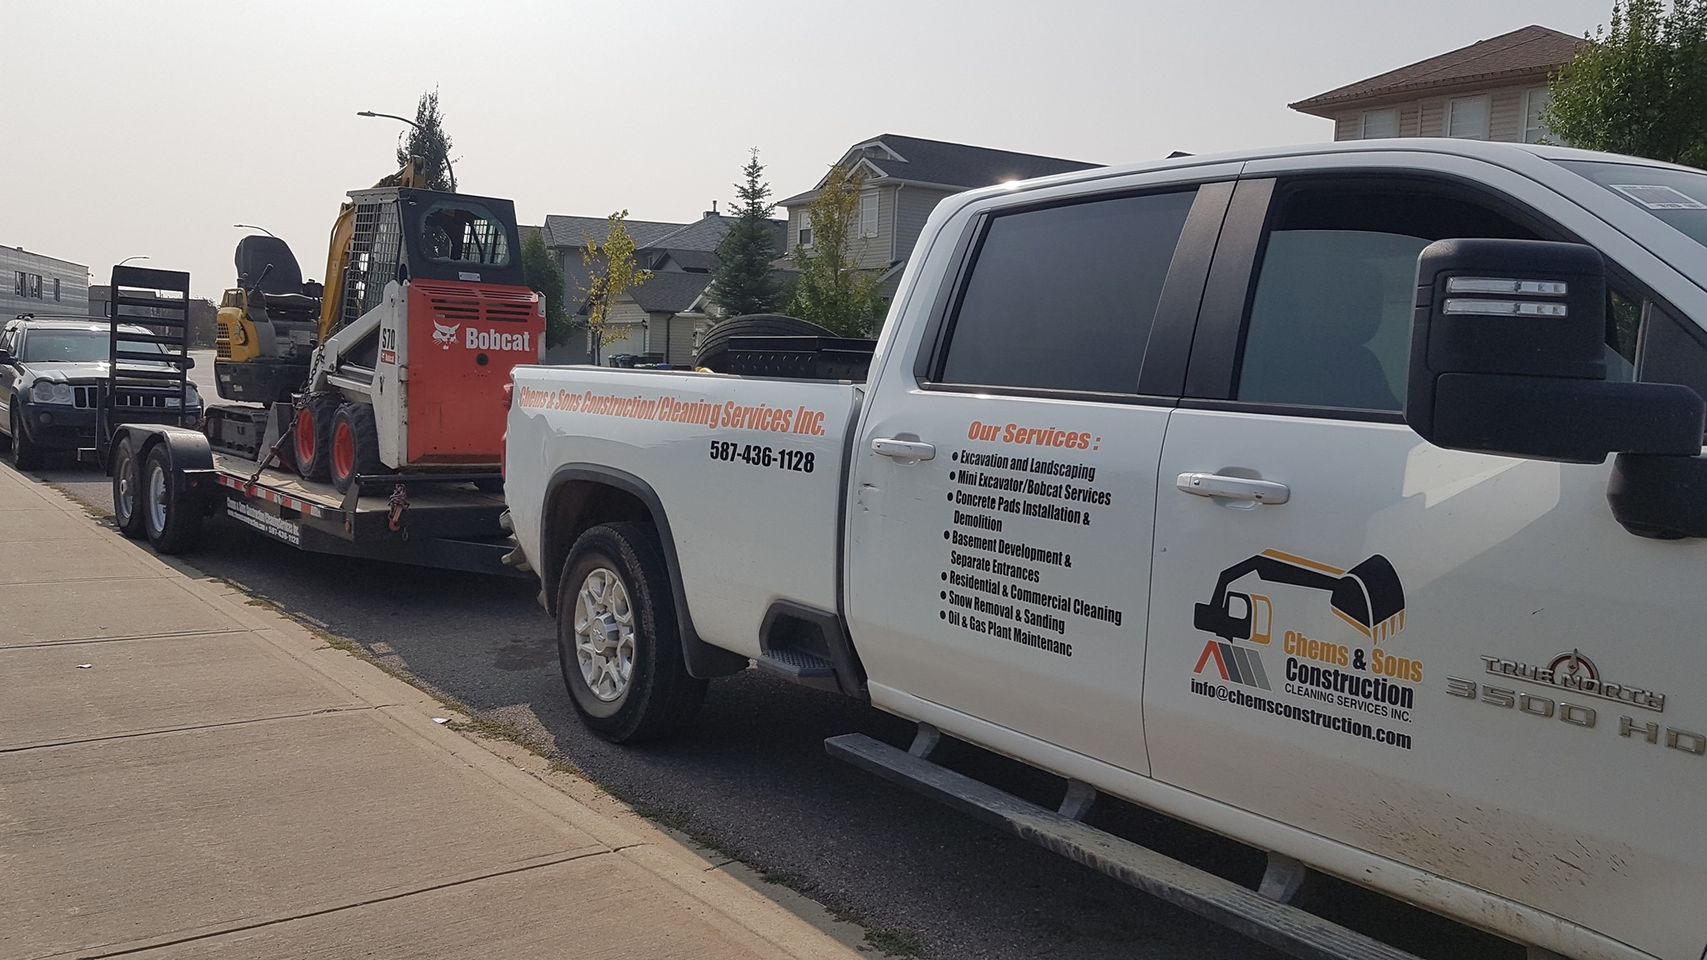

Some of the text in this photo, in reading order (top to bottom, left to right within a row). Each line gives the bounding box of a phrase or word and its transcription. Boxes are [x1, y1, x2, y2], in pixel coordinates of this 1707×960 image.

[382, 328, 395, 350] S70
[465, 327, 530, 351] Bobcat
[519, 386, 826, 436] Chems & Sons Construction/Cleaning Services Inc.
[968, 420, 1001, 442] Our
[1002, 423, 1091, 450] Services
[710, 440, 814, 474] 587-436-1128
[960, 450, 1096, 483] Excavation and Landscaping
[957, 470, 1112, 506] Mini Excavator/Bobcat Services
[953, 510, 1003, 533] Demolition
[955, 490, 1092, 526] Concrete Pads Installation &
[950, 550, 1041, 583] Separate Entrances
[952, 530, 1073, 568] Basement Development &
[948, 590, 1066, 635] Snow Removal & Sanding
[949, 570, 1123, 627] Residential & Commercial Cleaning
[948, 610, 1073, 657] Oil & Gas Plant Maintenanc
[1283, 630, 1424, 683] Chems & Sons
[1285, 657, 1415, 710] Construction
[1480, 655, 1666, 709] TRUE NORTH
[1190, 678, 1413, 751] info@chemsconstruction.com
[1284, 683, 1413, 724] CLEANING SERVICES INC.
[1446, 676, 1706, 757] 3500 HD
